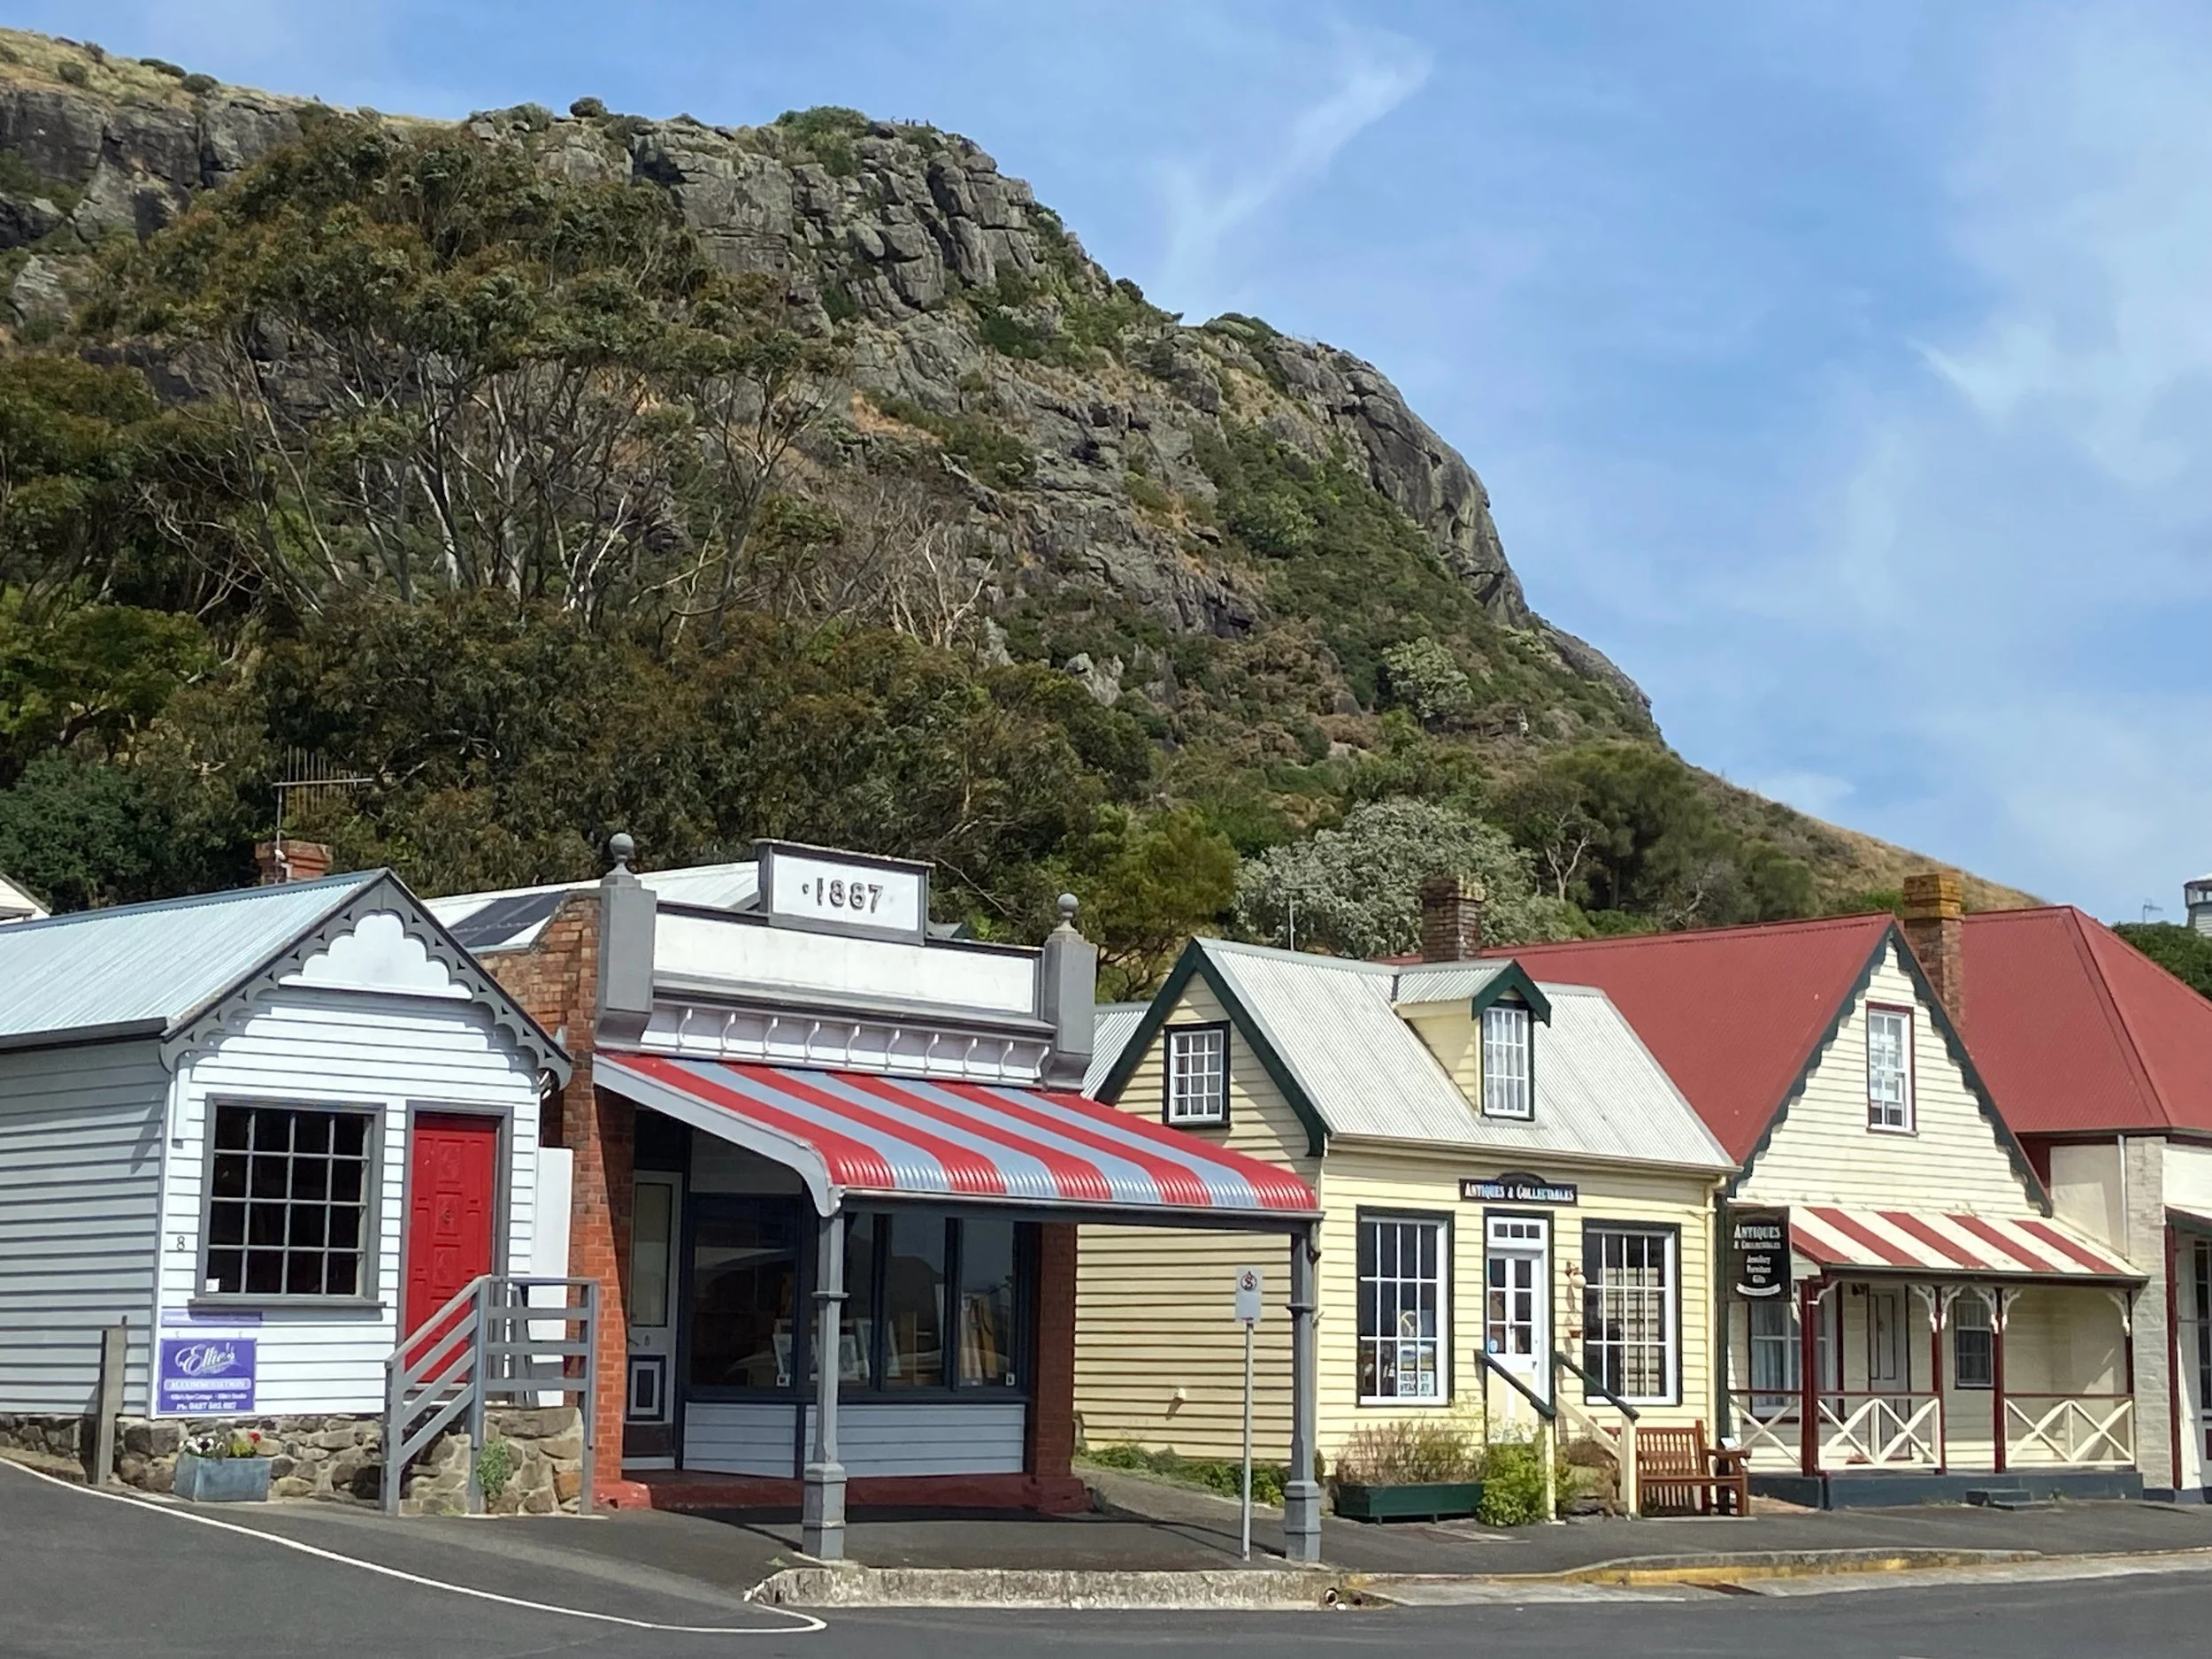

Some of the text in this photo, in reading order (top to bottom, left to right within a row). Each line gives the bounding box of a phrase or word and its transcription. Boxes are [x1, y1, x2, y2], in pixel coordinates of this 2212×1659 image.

[1464, 1182, 1505, 1200] ANTIQUES
[1507, 1186, 1515, 1199] &
[1734, 1224, 1781, 1240] ANTIQUES
[177, 1235, 186, 1250] 8
[1733, 1240, 1740, 1249] &
[175, 1342, 237, 1376] Ellie's
[1400, 1383, 1430, 1392] STANEY
